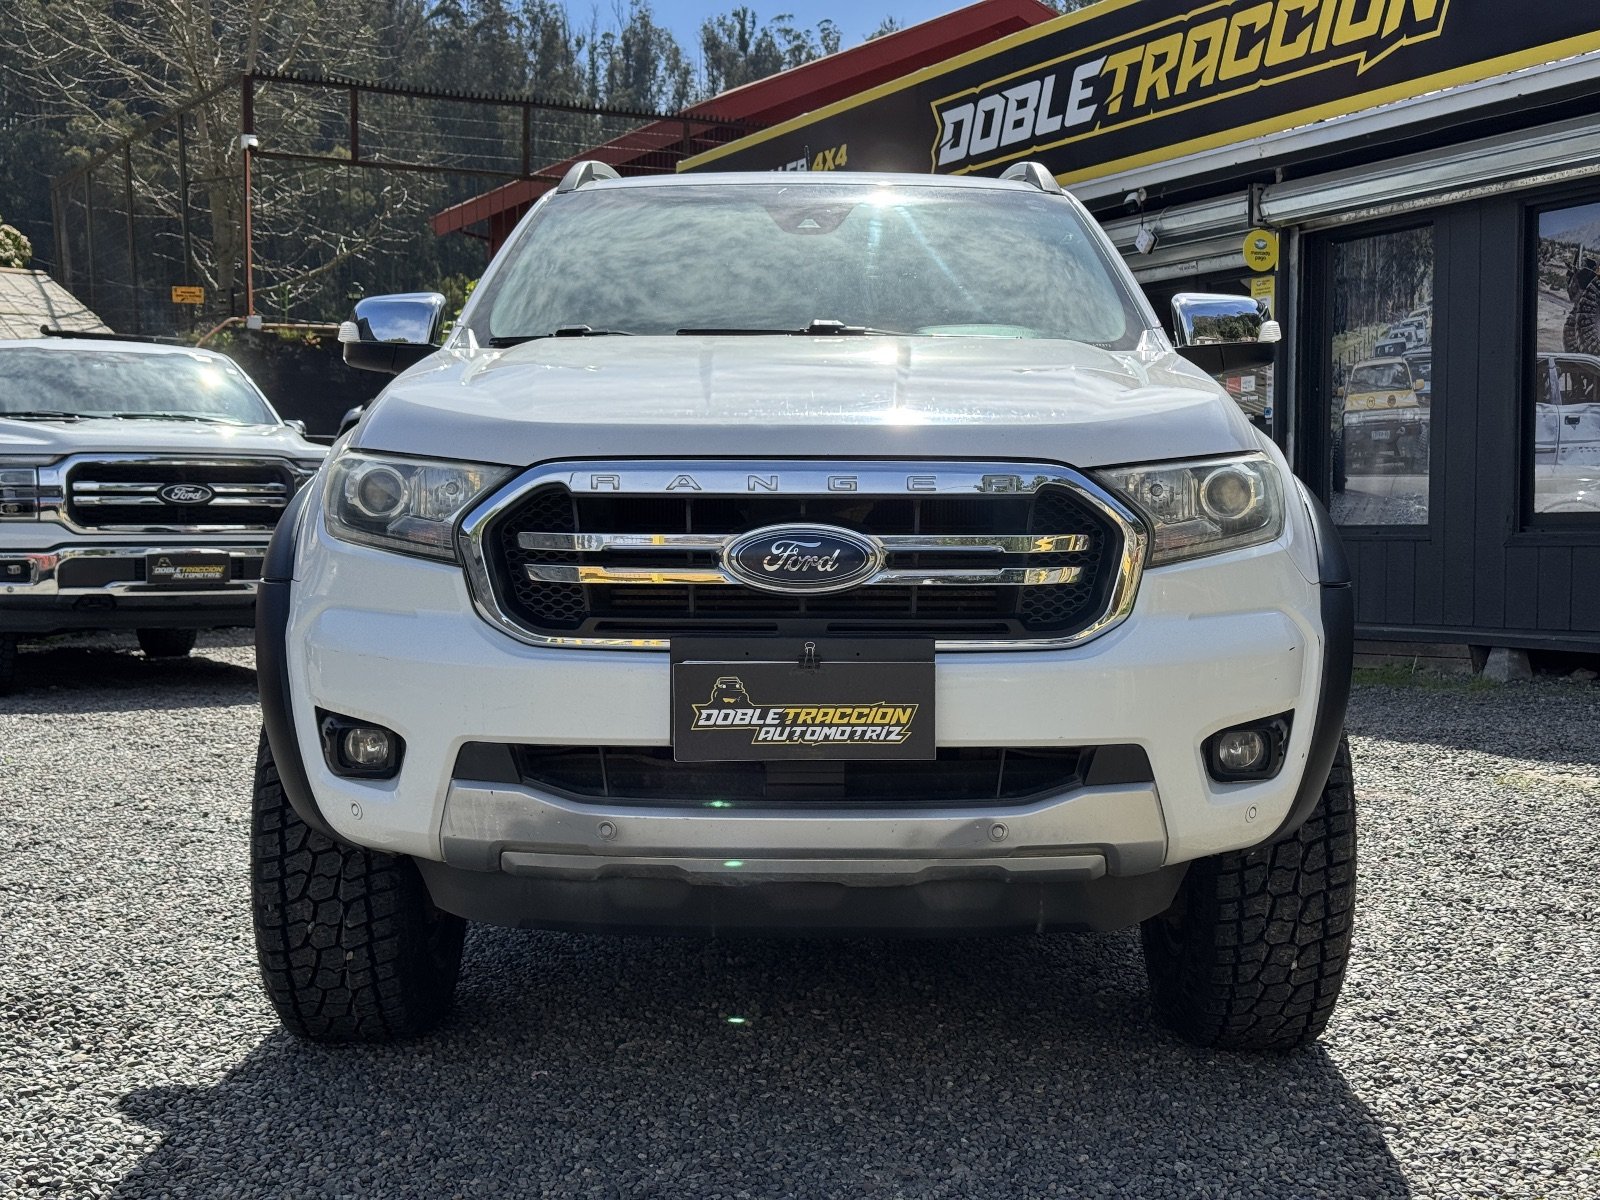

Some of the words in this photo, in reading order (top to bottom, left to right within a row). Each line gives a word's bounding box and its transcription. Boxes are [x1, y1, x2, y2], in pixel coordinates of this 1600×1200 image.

[591, 474, 1018, 492] RANGER
[171, 487, 202, 500] Ford
[763, 540, 841, 572] Ford
[757, 726, 904, 741] AUTOMOTRIZ
